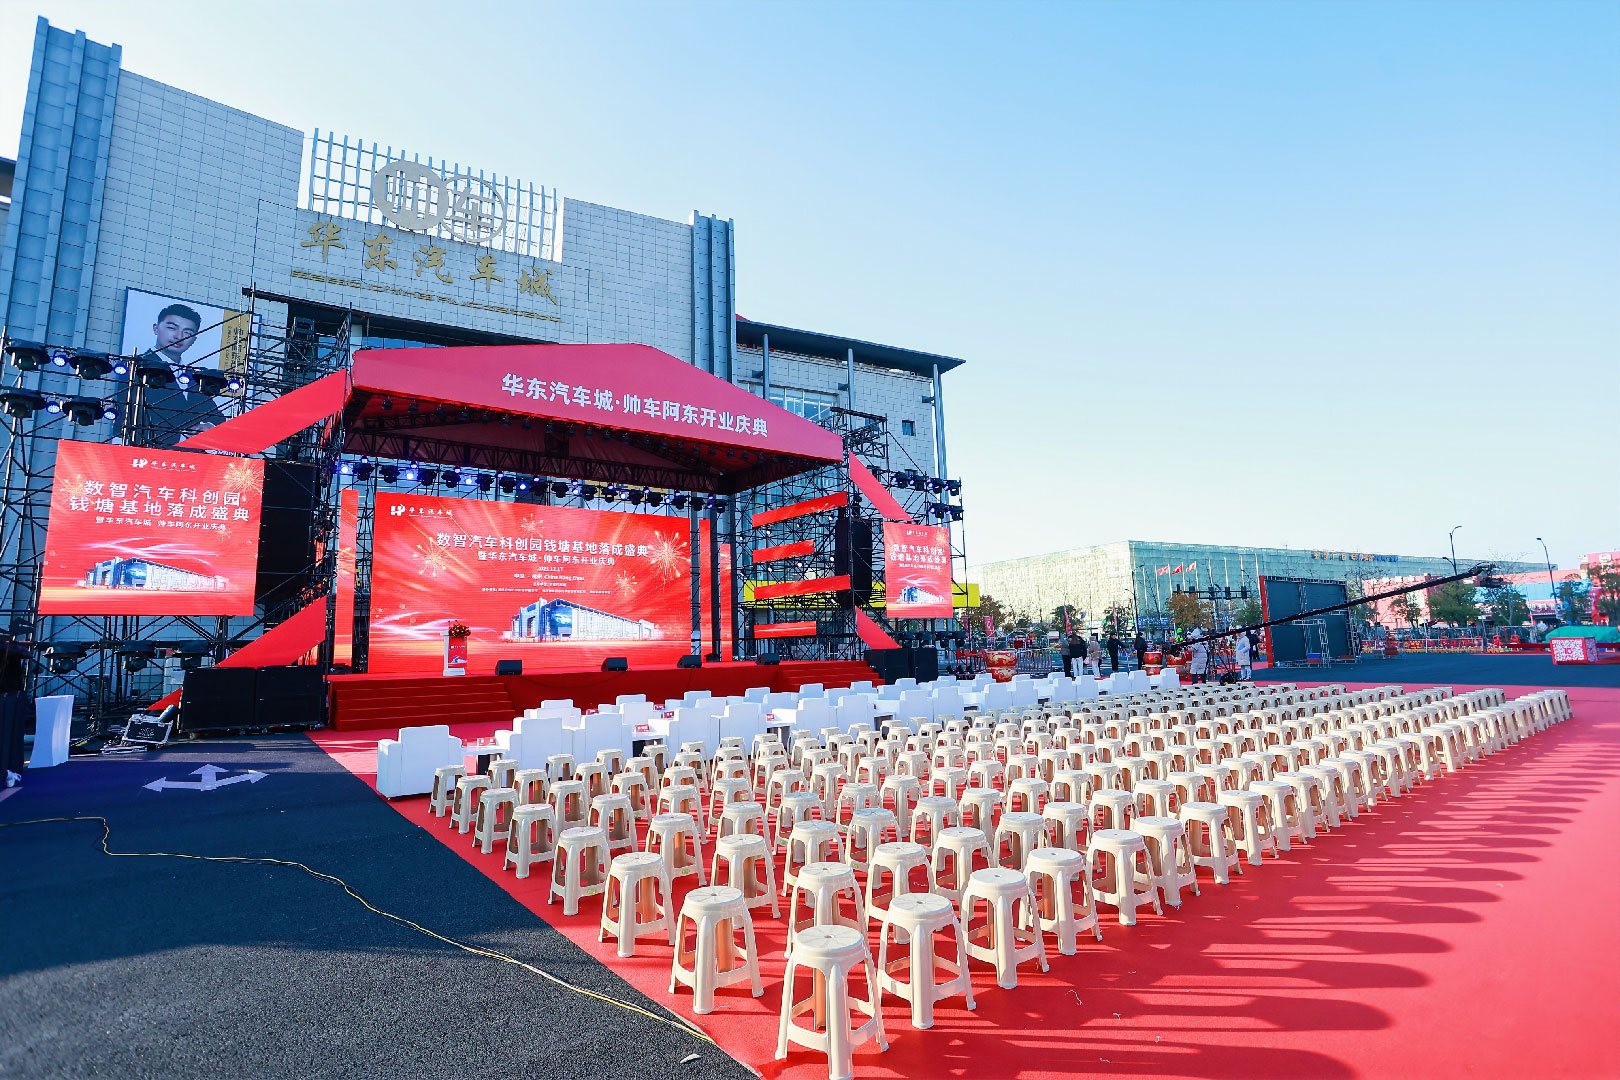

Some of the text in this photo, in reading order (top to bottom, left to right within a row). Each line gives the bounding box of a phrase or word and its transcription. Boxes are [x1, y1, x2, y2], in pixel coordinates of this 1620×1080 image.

[301, 221, 558, 305] 华东汽车城
[501, 373, 769, 438] 华东汽车城·帅车阿东开业庆典
[84, 480, 241, 506] 数智汽车科创园
[69, 496, 250, 522] 钱塘基地落成盛典
[436, 532, 649, 558] 数智汽车科创园钱塘基地落成盛典
